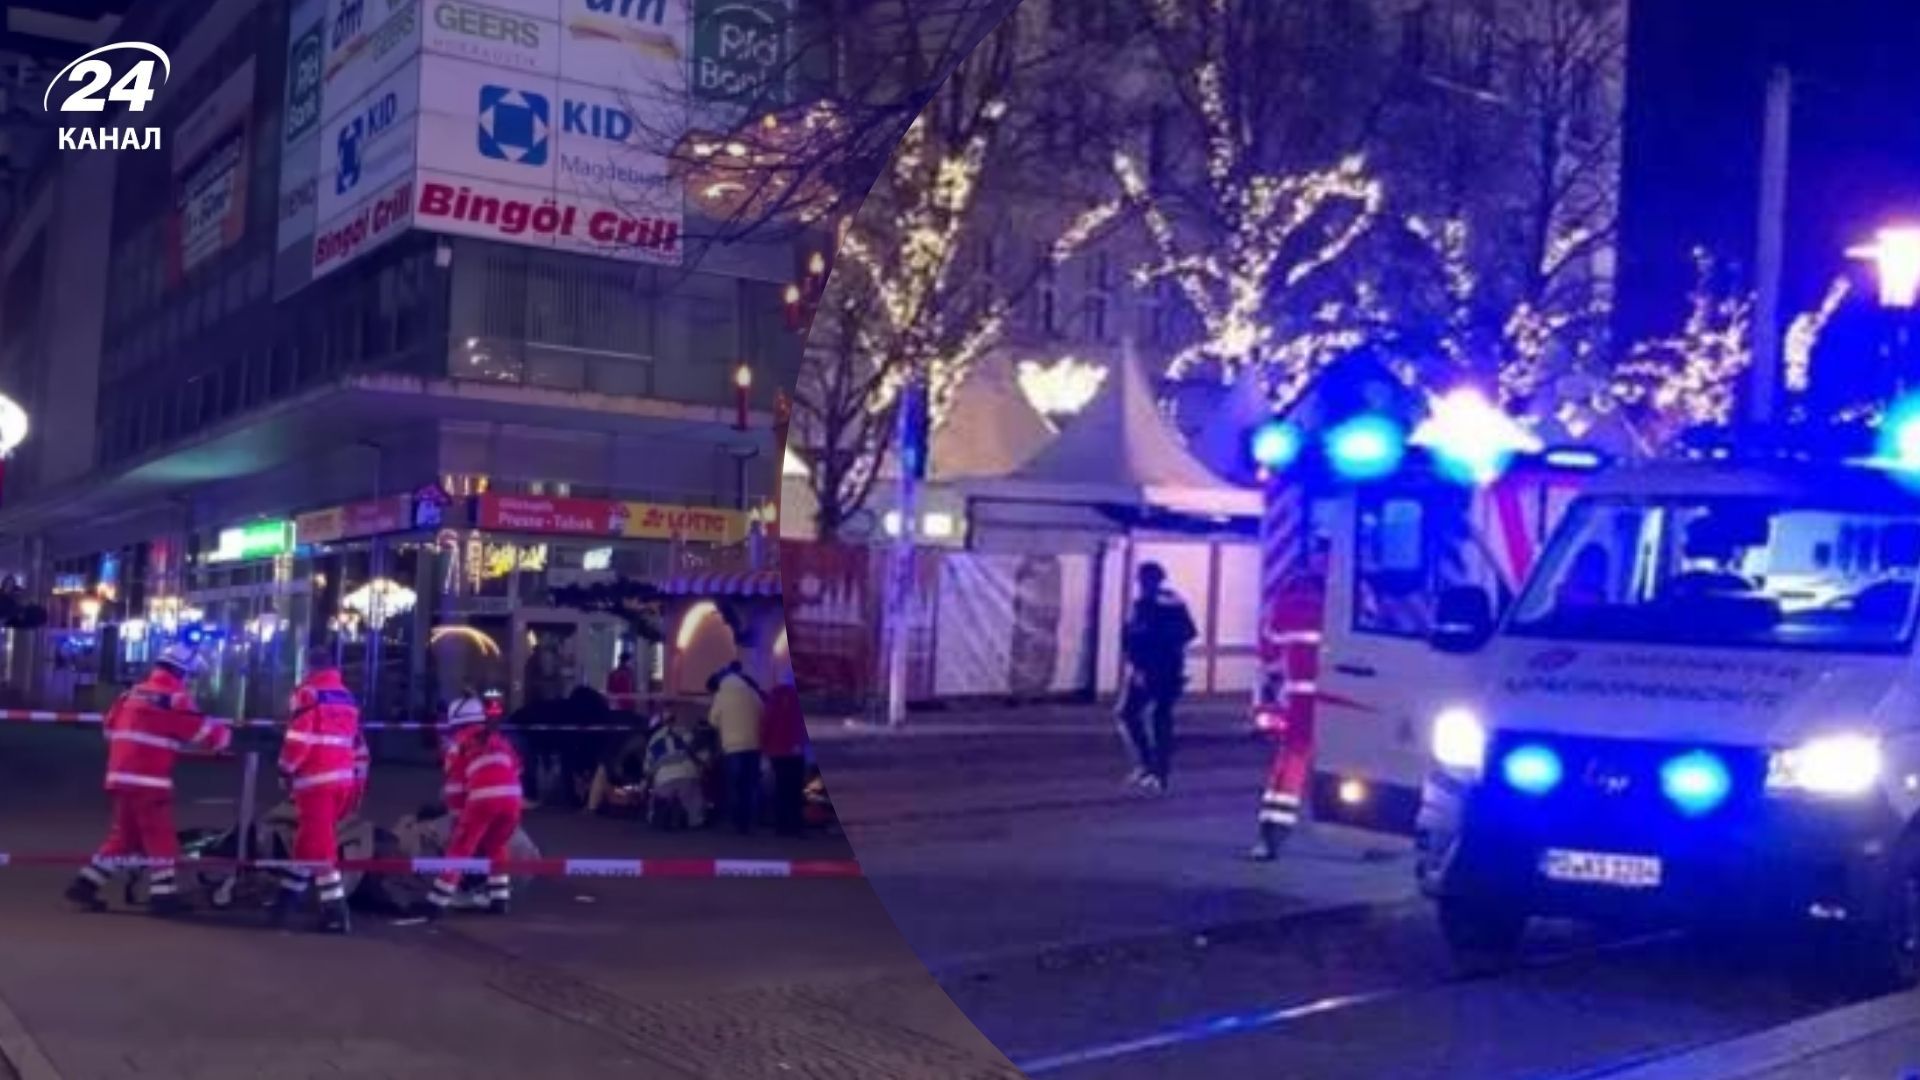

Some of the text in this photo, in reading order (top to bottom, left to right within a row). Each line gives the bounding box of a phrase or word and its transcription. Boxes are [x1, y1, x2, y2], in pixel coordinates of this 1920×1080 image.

[433, 3, 540, 49] GEERS
[367, 91, 397, 139] KID
[562, 99, 633, 143] KID
[417, 182, 679, 250] Bingöl Grill
